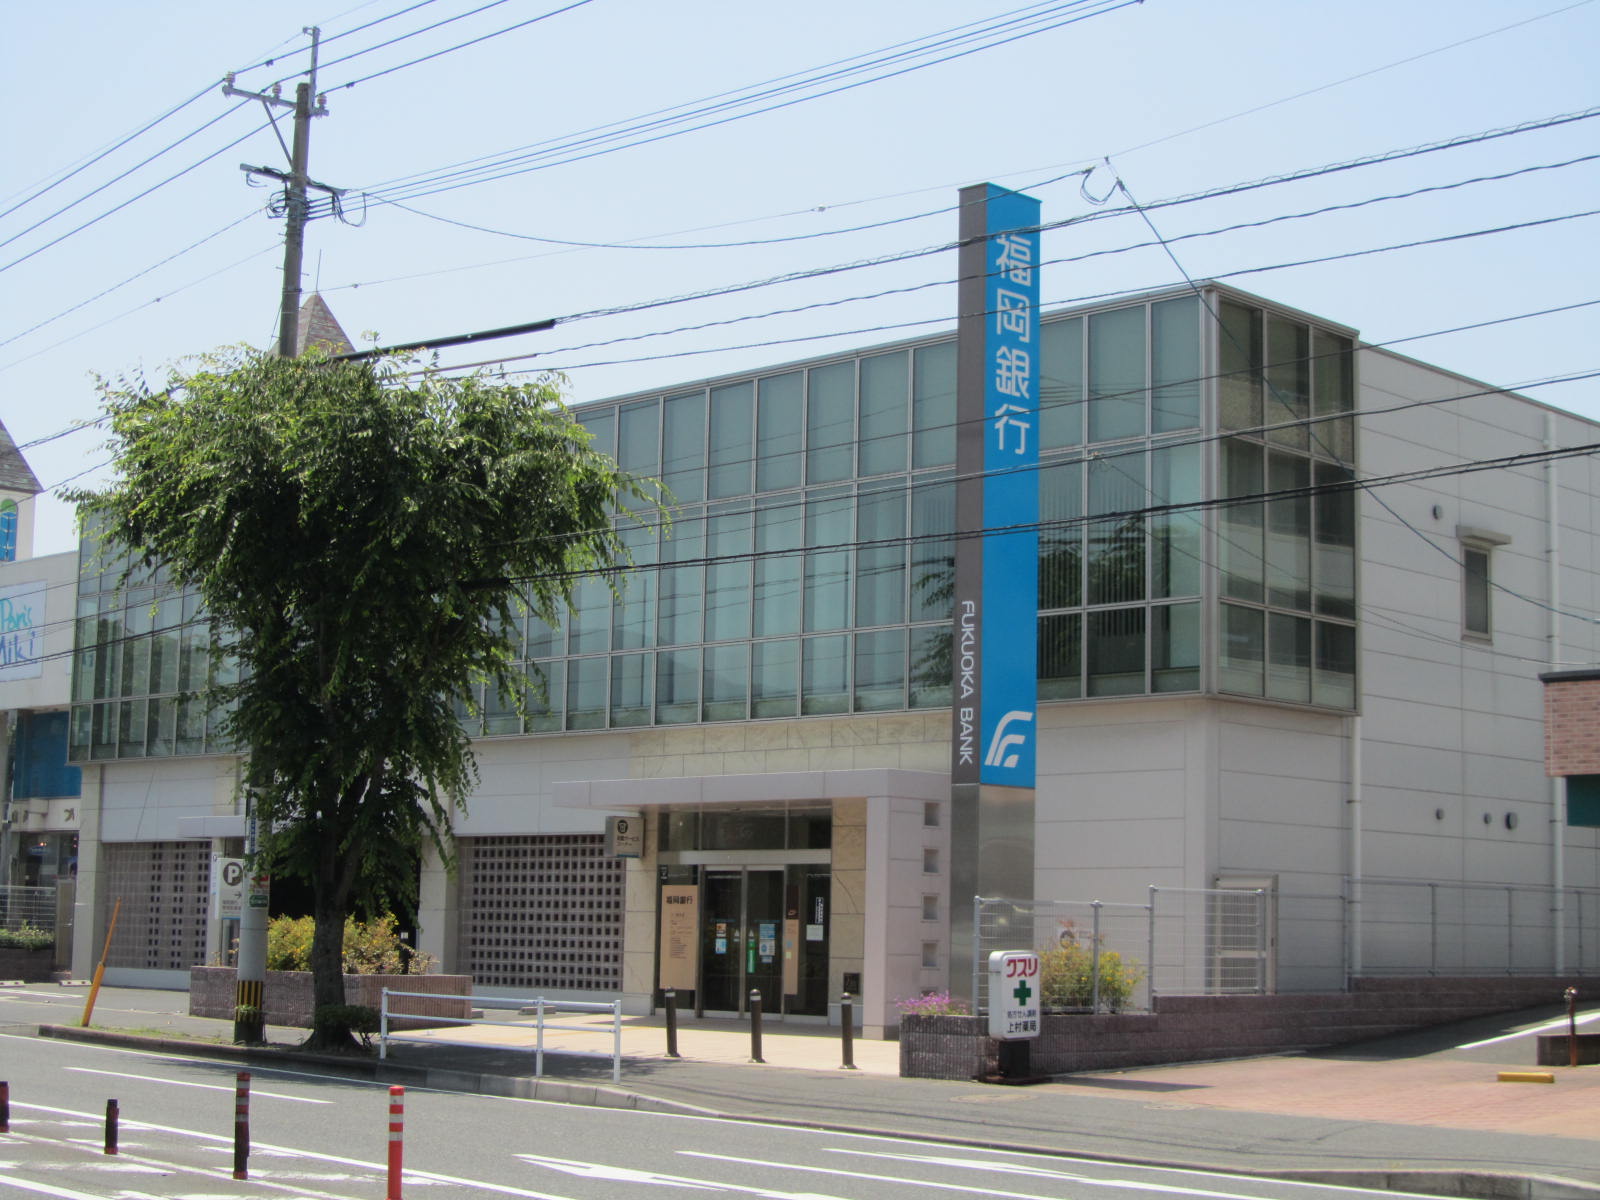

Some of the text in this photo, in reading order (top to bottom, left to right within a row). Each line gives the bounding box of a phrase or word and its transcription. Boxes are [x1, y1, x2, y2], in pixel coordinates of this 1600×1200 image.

[994, 233, 1032, 455] 福岡銀行
[0, 599, 33, 633] Paris
[960, 601, 975, 766] FUKUOKA BANK
[227, 865, 240, 883] P
[1006, 959, 1038, 978] クスリ
[1008, 1021, 1037, 1033] 上村薬局
